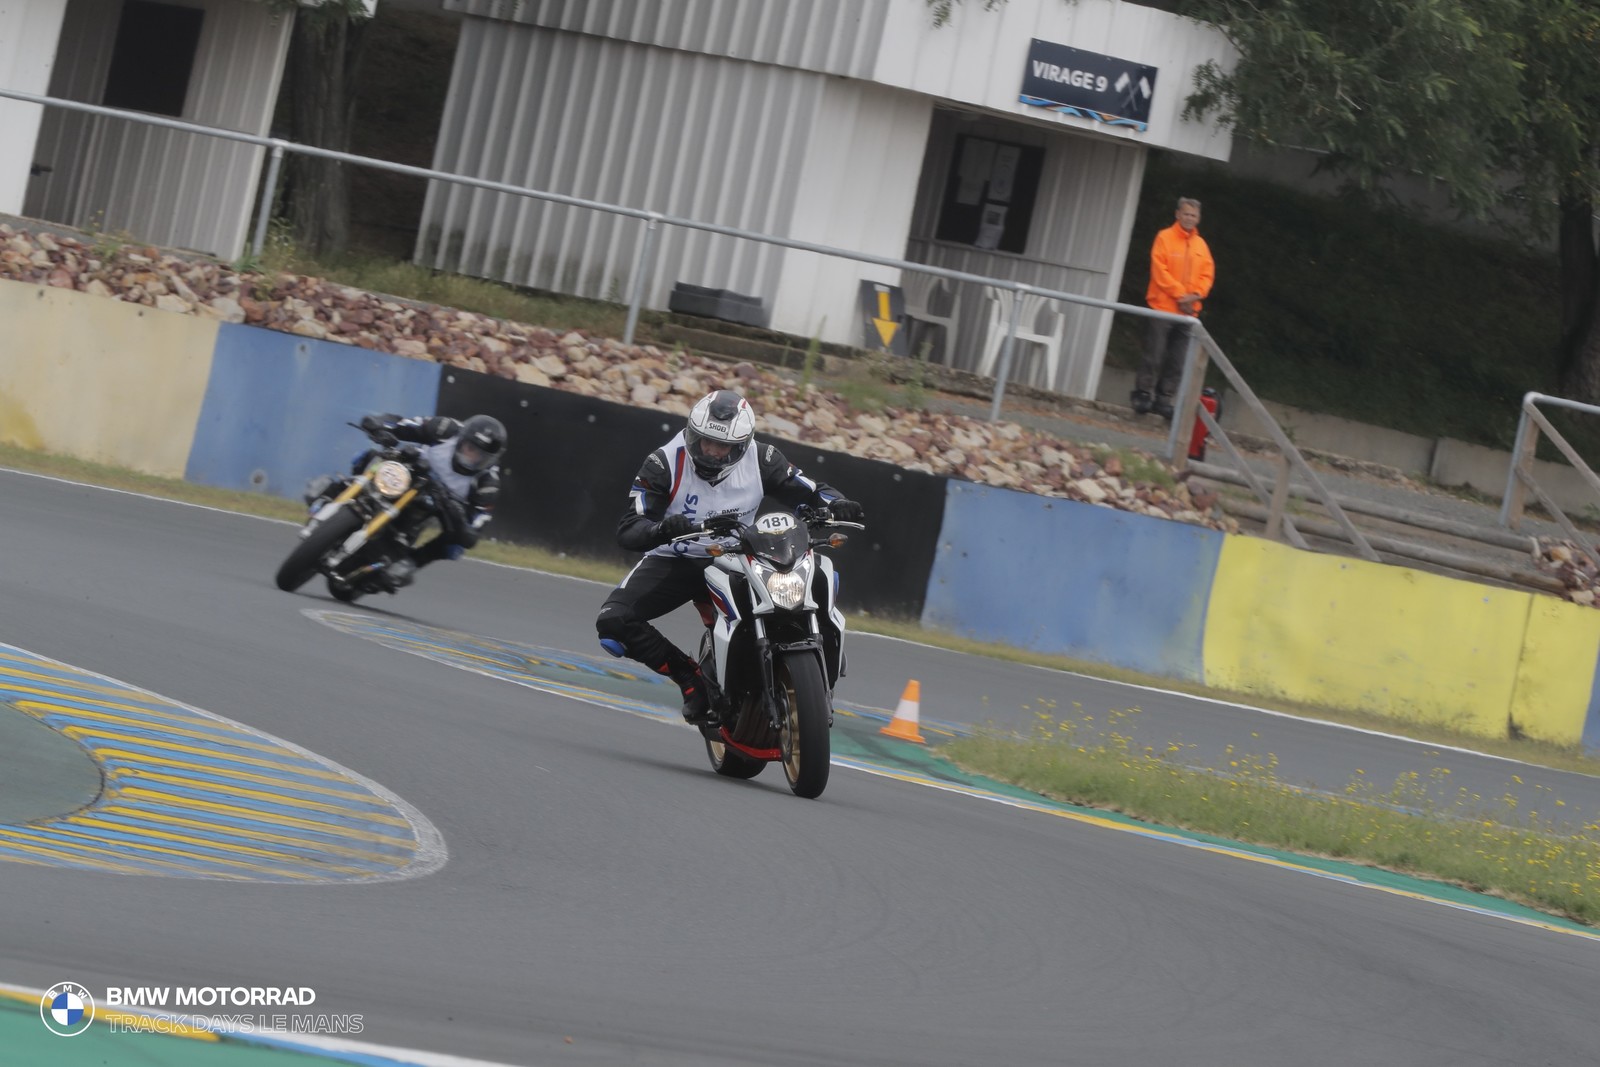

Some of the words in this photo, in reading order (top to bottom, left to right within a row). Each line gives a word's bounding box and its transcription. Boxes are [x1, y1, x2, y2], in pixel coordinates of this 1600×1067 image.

[1032, 59, 1094, 90] VIRAGE
[1095, 76, 1108, 92] 9
[708, 422, 727, 433] SHOEI
[762, 516, 789, 528] 181
